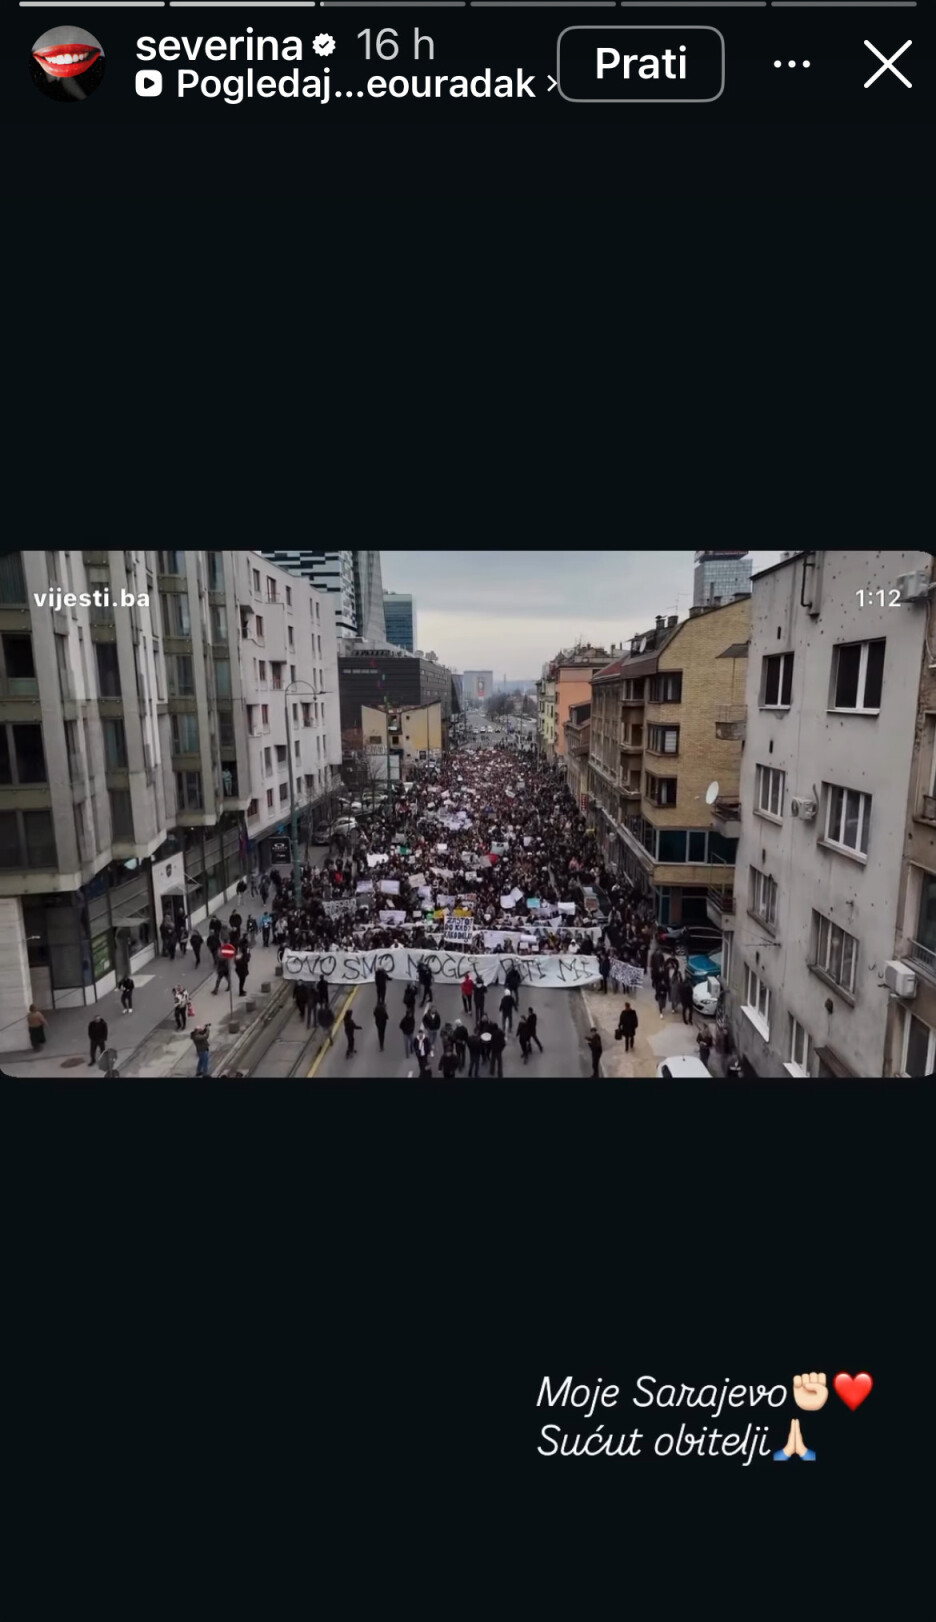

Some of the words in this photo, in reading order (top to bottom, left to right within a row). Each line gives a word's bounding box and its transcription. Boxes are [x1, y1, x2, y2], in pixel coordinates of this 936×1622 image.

[285, 955, 337, 976] OVO
[342, 953, 395, 980] SMO
[557, 957, 593, 982] MI
